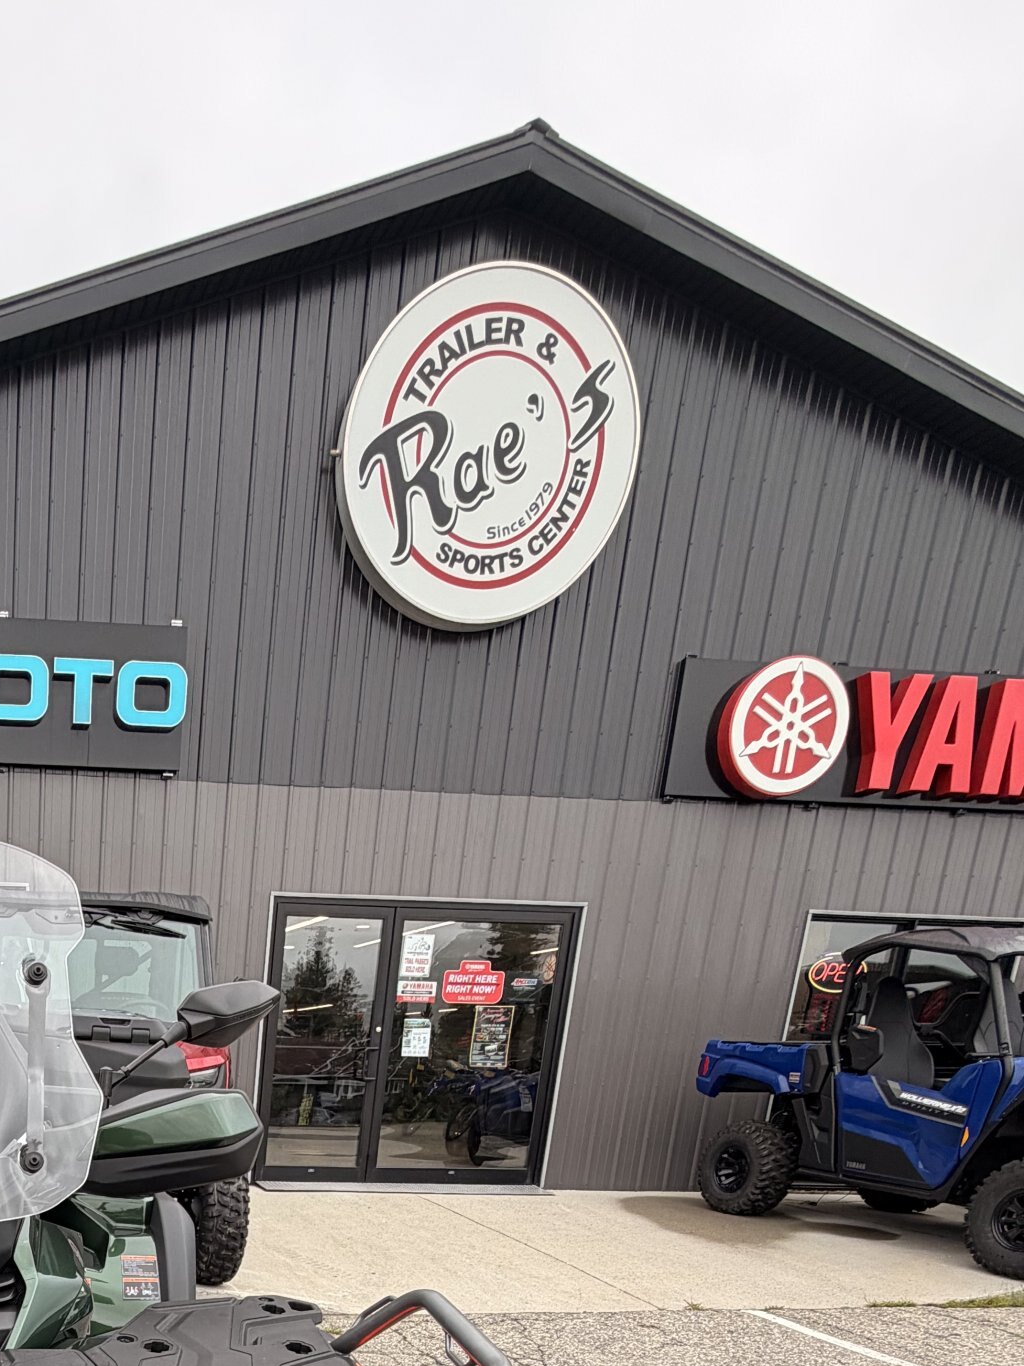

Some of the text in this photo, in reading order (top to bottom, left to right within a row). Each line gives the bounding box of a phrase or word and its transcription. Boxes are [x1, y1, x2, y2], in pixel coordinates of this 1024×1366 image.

[403, 316, 559, 405] TRAILER &
[436, 457, 592, 576] SPORTS CENTER
[487, 481, 553, 540] Since 1979
[409, 982, 434, 990] YAMAHA
[446, 984, 496, 994] RIGHT NOW!
[448, 973, 499, 984] RIGHT HERE
